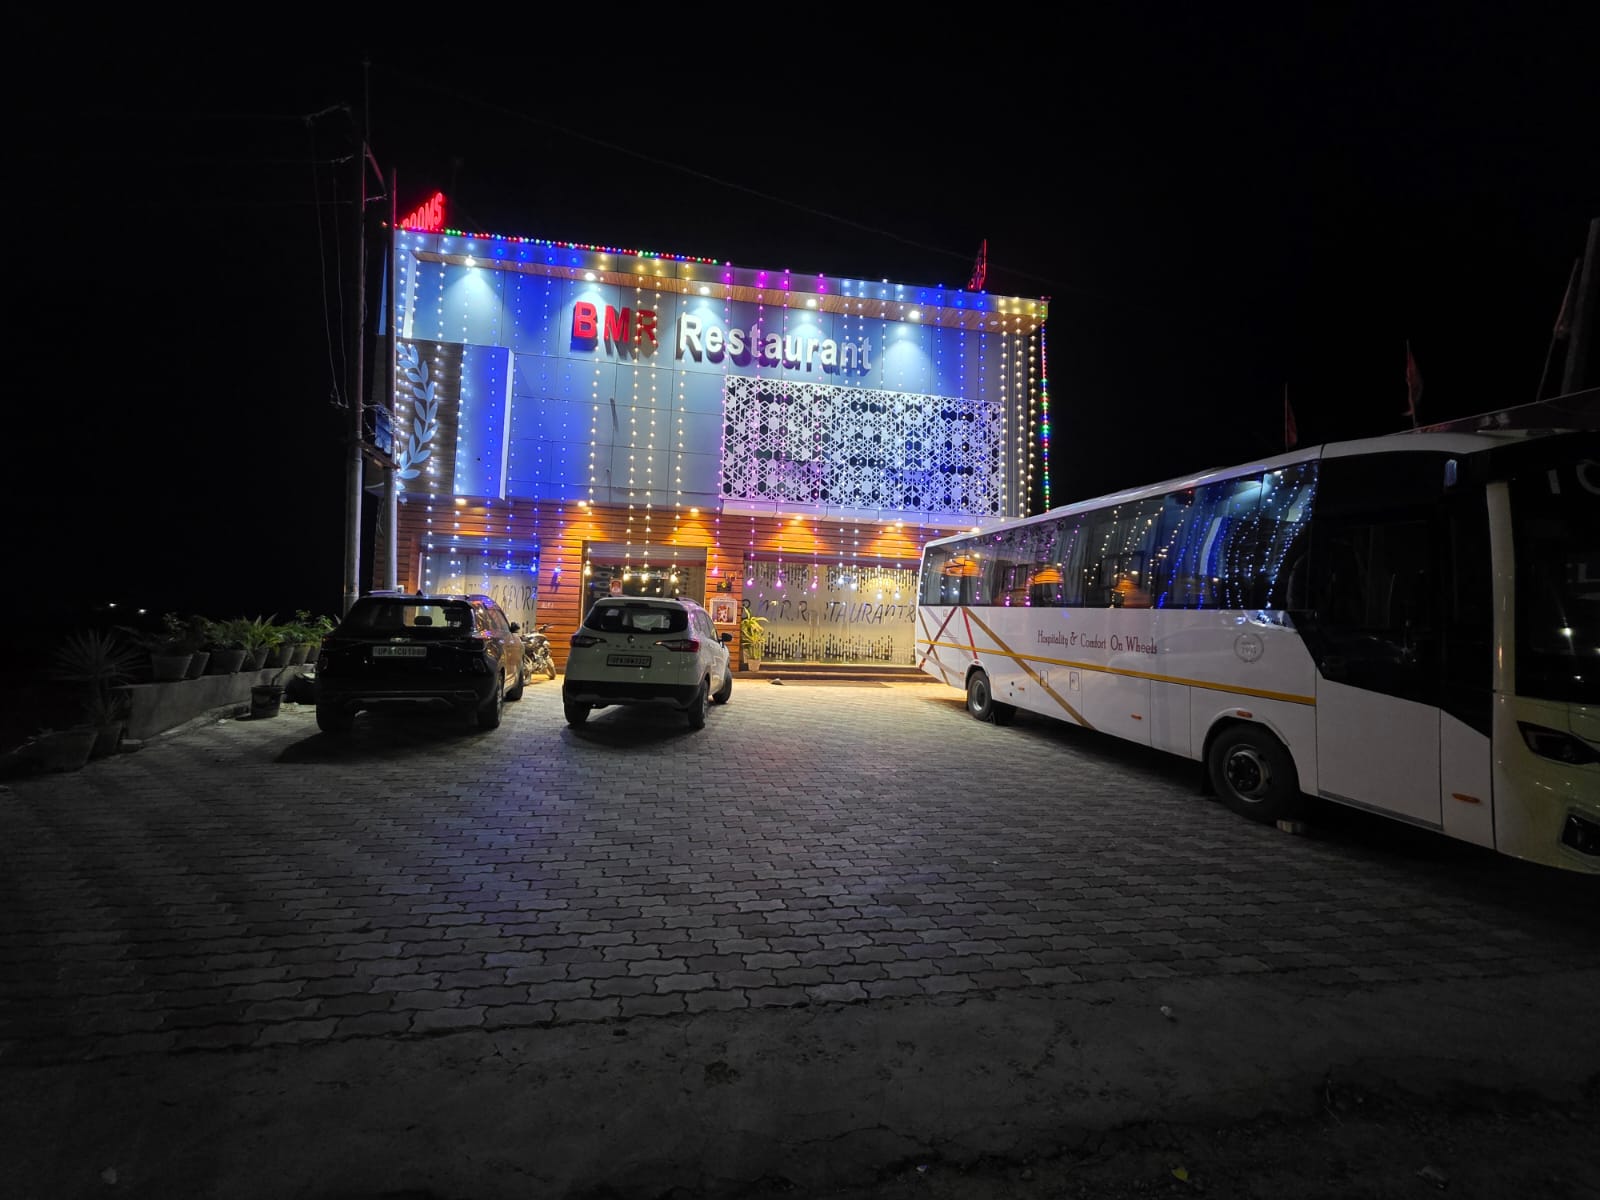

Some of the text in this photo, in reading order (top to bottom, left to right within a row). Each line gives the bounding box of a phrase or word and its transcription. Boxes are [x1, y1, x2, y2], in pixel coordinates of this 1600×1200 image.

[573, 301, 873, 369] BMR Restaurant
[1037, 629, 1157, 654] Hospitality & Comfort On Wheels
